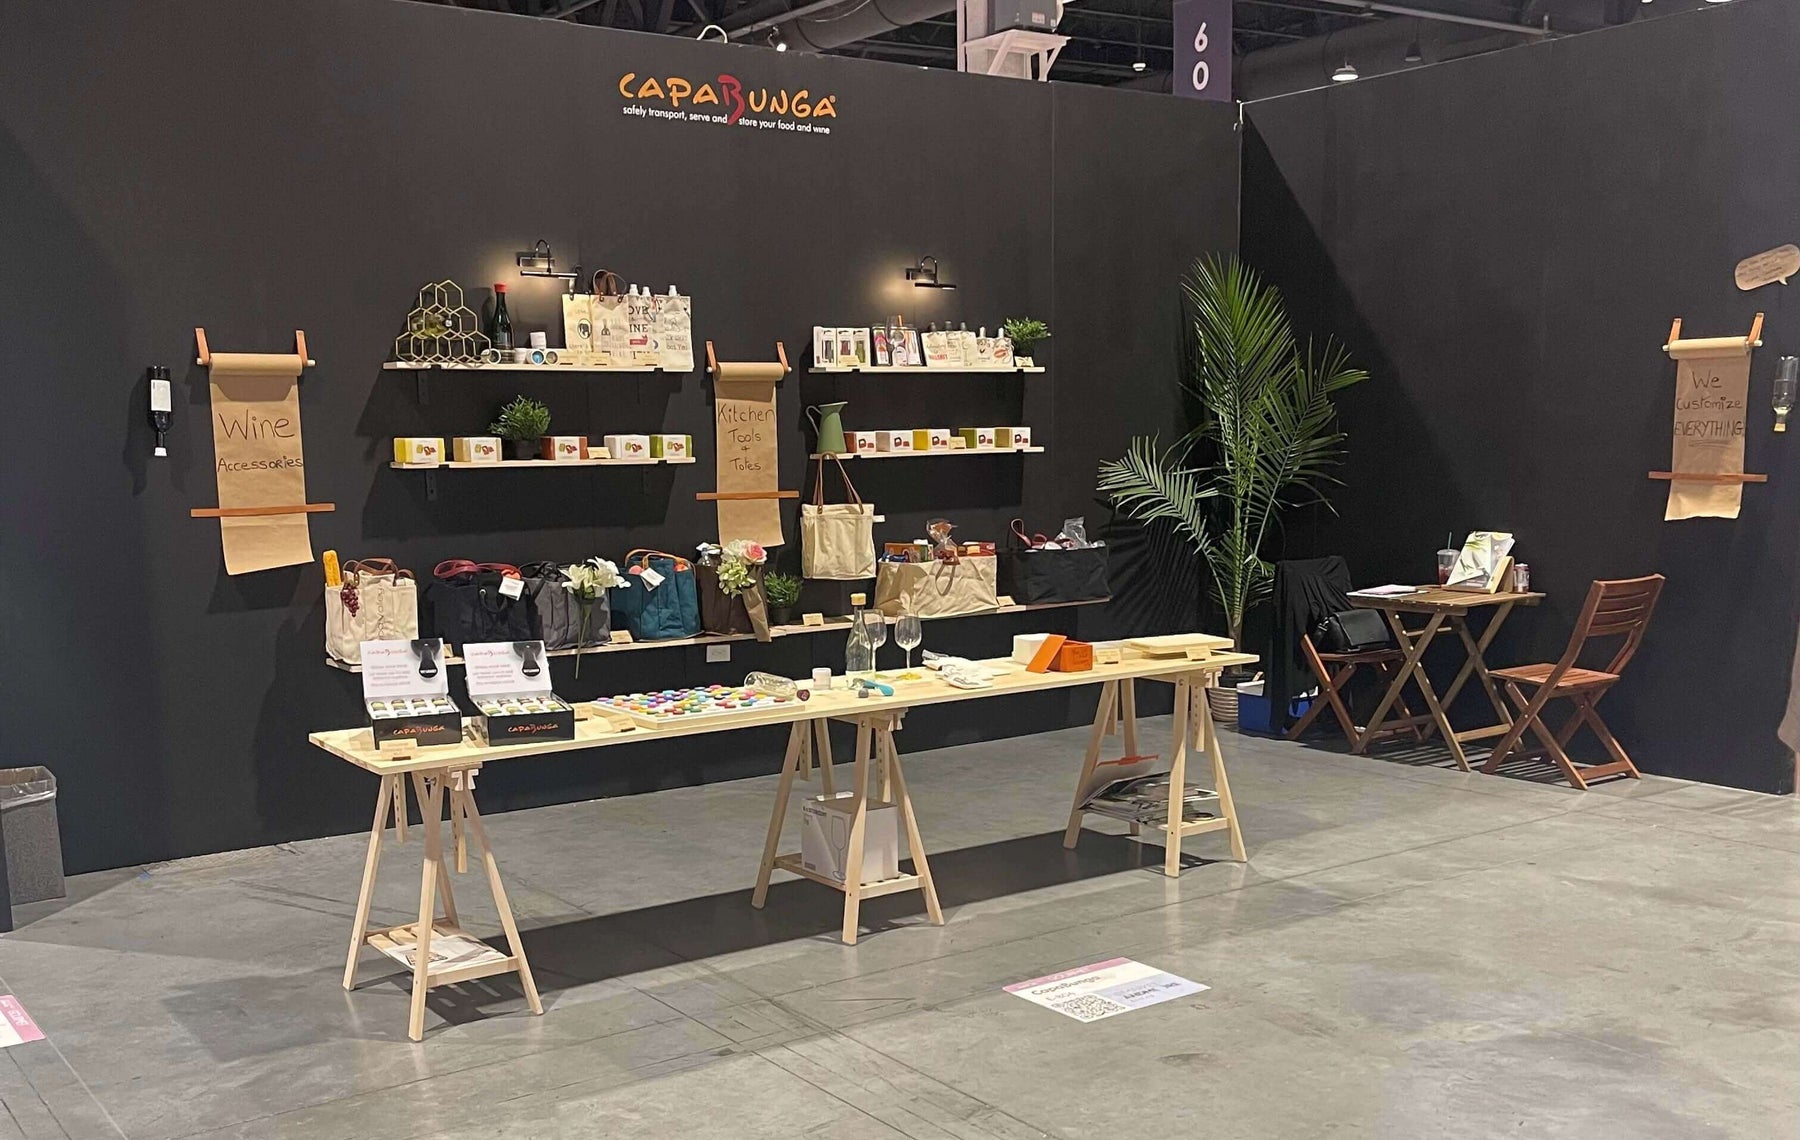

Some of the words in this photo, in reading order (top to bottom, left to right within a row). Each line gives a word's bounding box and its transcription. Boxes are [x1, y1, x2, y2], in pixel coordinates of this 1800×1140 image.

[622, 104, 647, 118] safely
[648, 107, 688, 121] transport,
[689, 113, 710, 122] serve
[711, 114, 728, 124] and
[738, 117, 758, 127] store
[758, 120, 776, 129] your
[777, 119, 796, 131] food
[796, 122, 812, 132] and
[812, 126, 831, 134] wine
[629, 323, 649, 333] INE
[1692, 369, 1723, 389] We
[717, 402, 776, 425] Kitchen
[218, 409, 296, 441] Wine
[727, 427, 762, 443] Tools
[728, 457, 762, 471] Totes
